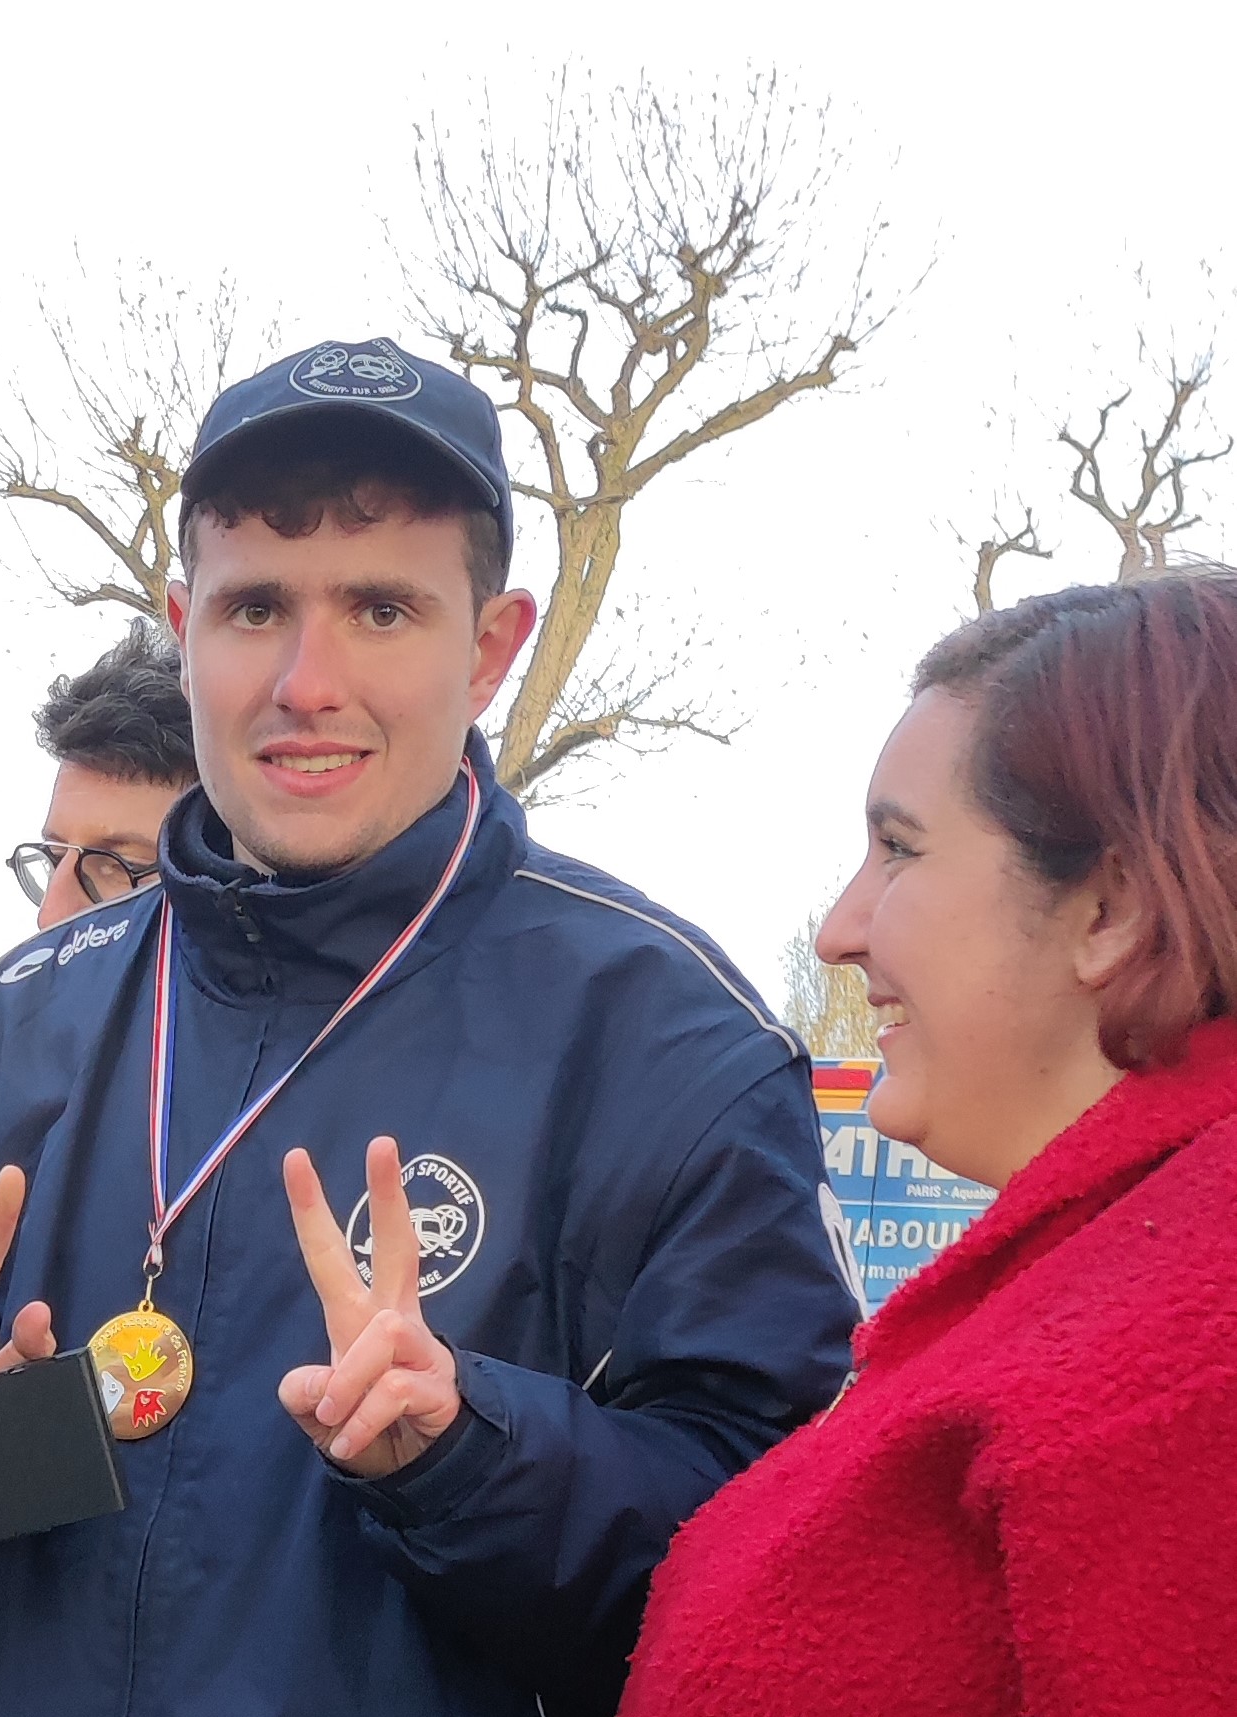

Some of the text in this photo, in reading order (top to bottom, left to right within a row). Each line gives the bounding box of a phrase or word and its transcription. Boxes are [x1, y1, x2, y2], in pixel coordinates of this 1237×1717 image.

[58, 919, 129, 966] elders
[416, 1161, 475, 1206] SPORTIF
[905, 1184, 942, 1198] PARIS
